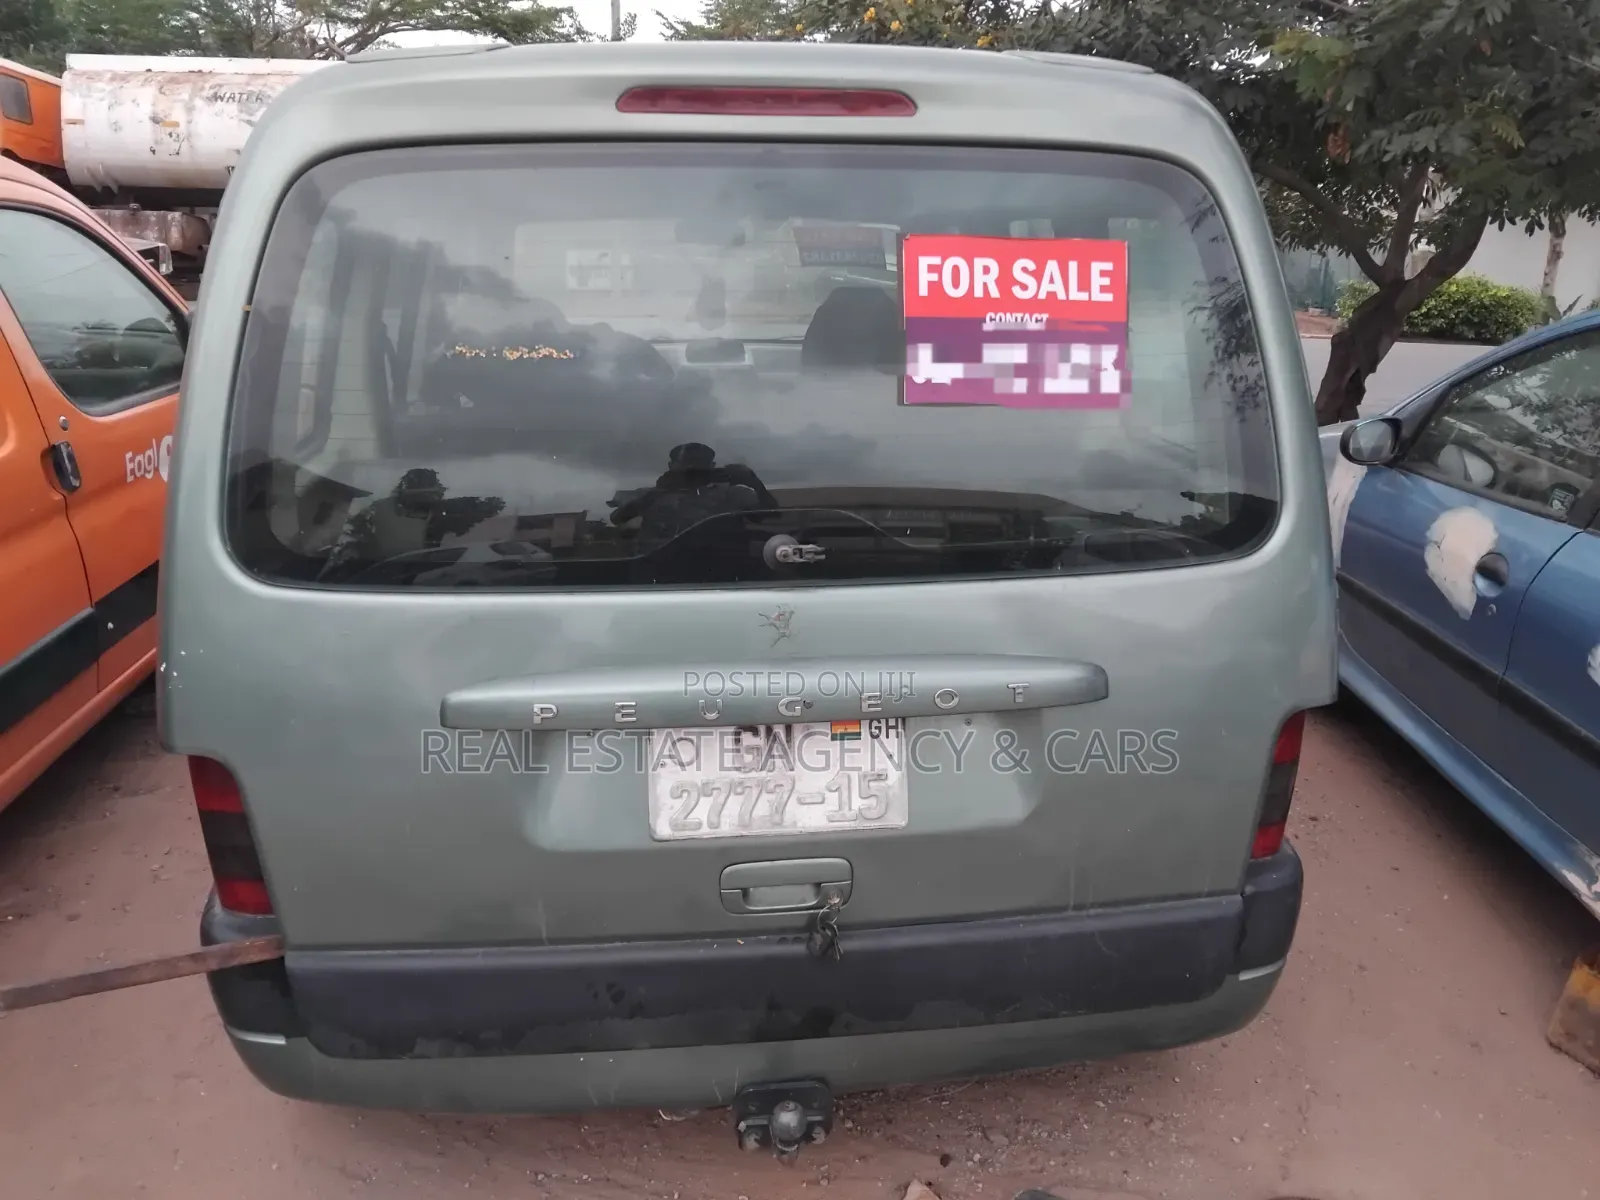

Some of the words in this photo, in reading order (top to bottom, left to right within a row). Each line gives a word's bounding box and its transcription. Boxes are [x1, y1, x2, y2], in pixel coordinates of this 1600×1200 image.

[918, 256, 1000, 298] FOR
[1011, 258, 1113, 301] SALE
[985, 311, 1048, 326] CONTACT
[532, 682, 1031, 725] PEUGEOT
[868, 717, 899, 740] GH
[669, 771, 889, 831] 2777-15
